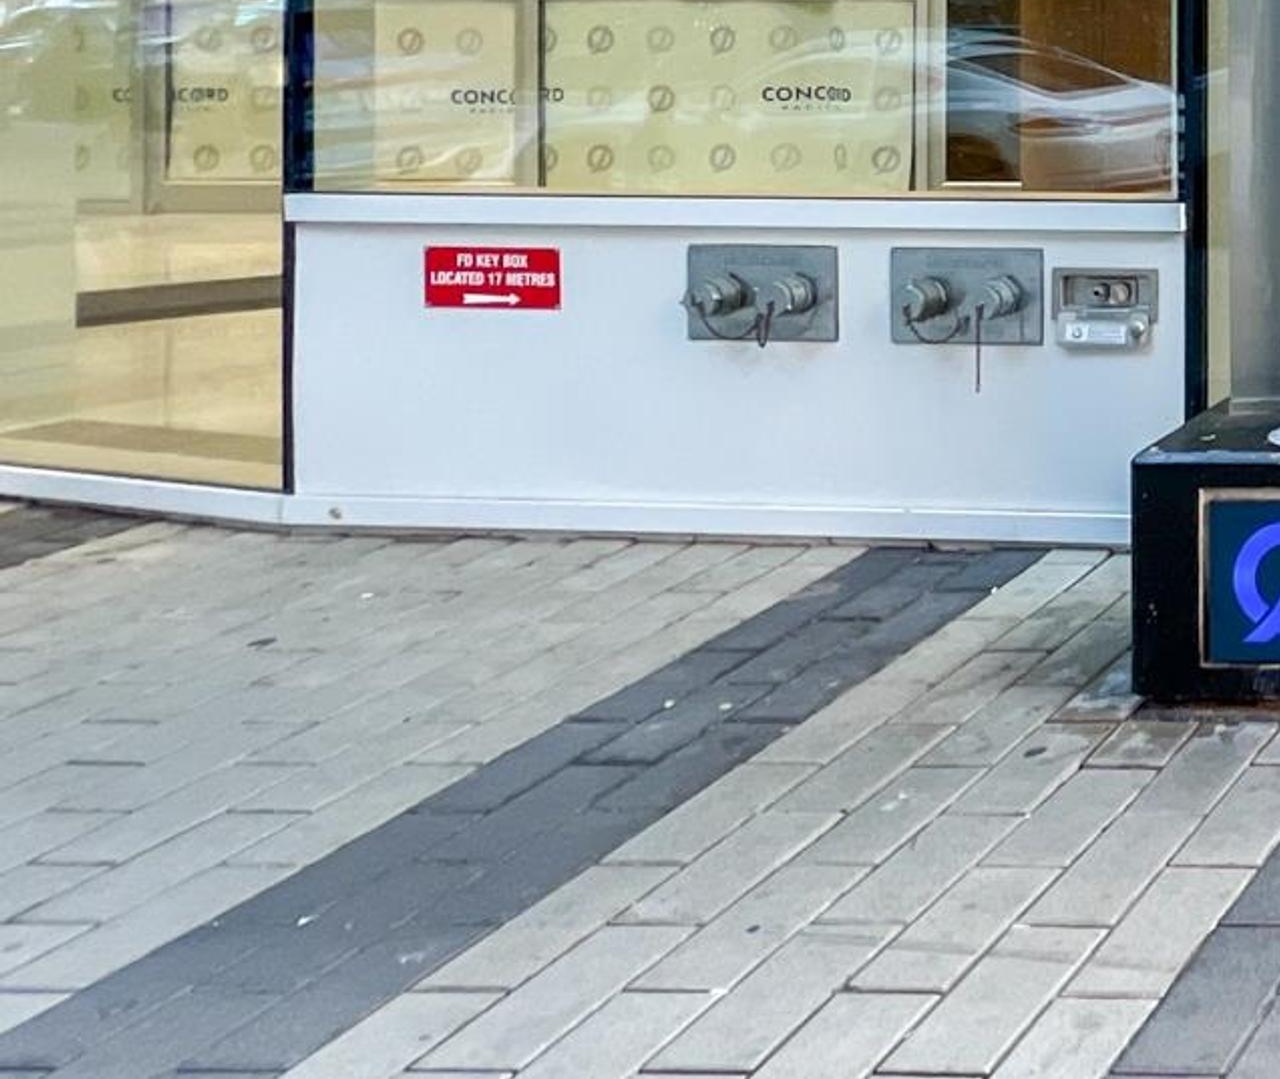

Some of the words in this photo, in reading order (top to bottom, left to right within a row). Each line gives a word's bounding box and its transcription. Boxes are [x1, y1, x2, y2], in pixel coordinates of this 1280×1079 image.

[112, 87, 230, 103] COCORD
[456, 253, 474, 268] FD
[476, 253, 500, 268] KEY
[503, 254, 528, 269] BOX
[430, 271, 485, 286] LOCATED
[488, 272, 502, 286] 17
[505, 272, 556, 287] METRES
